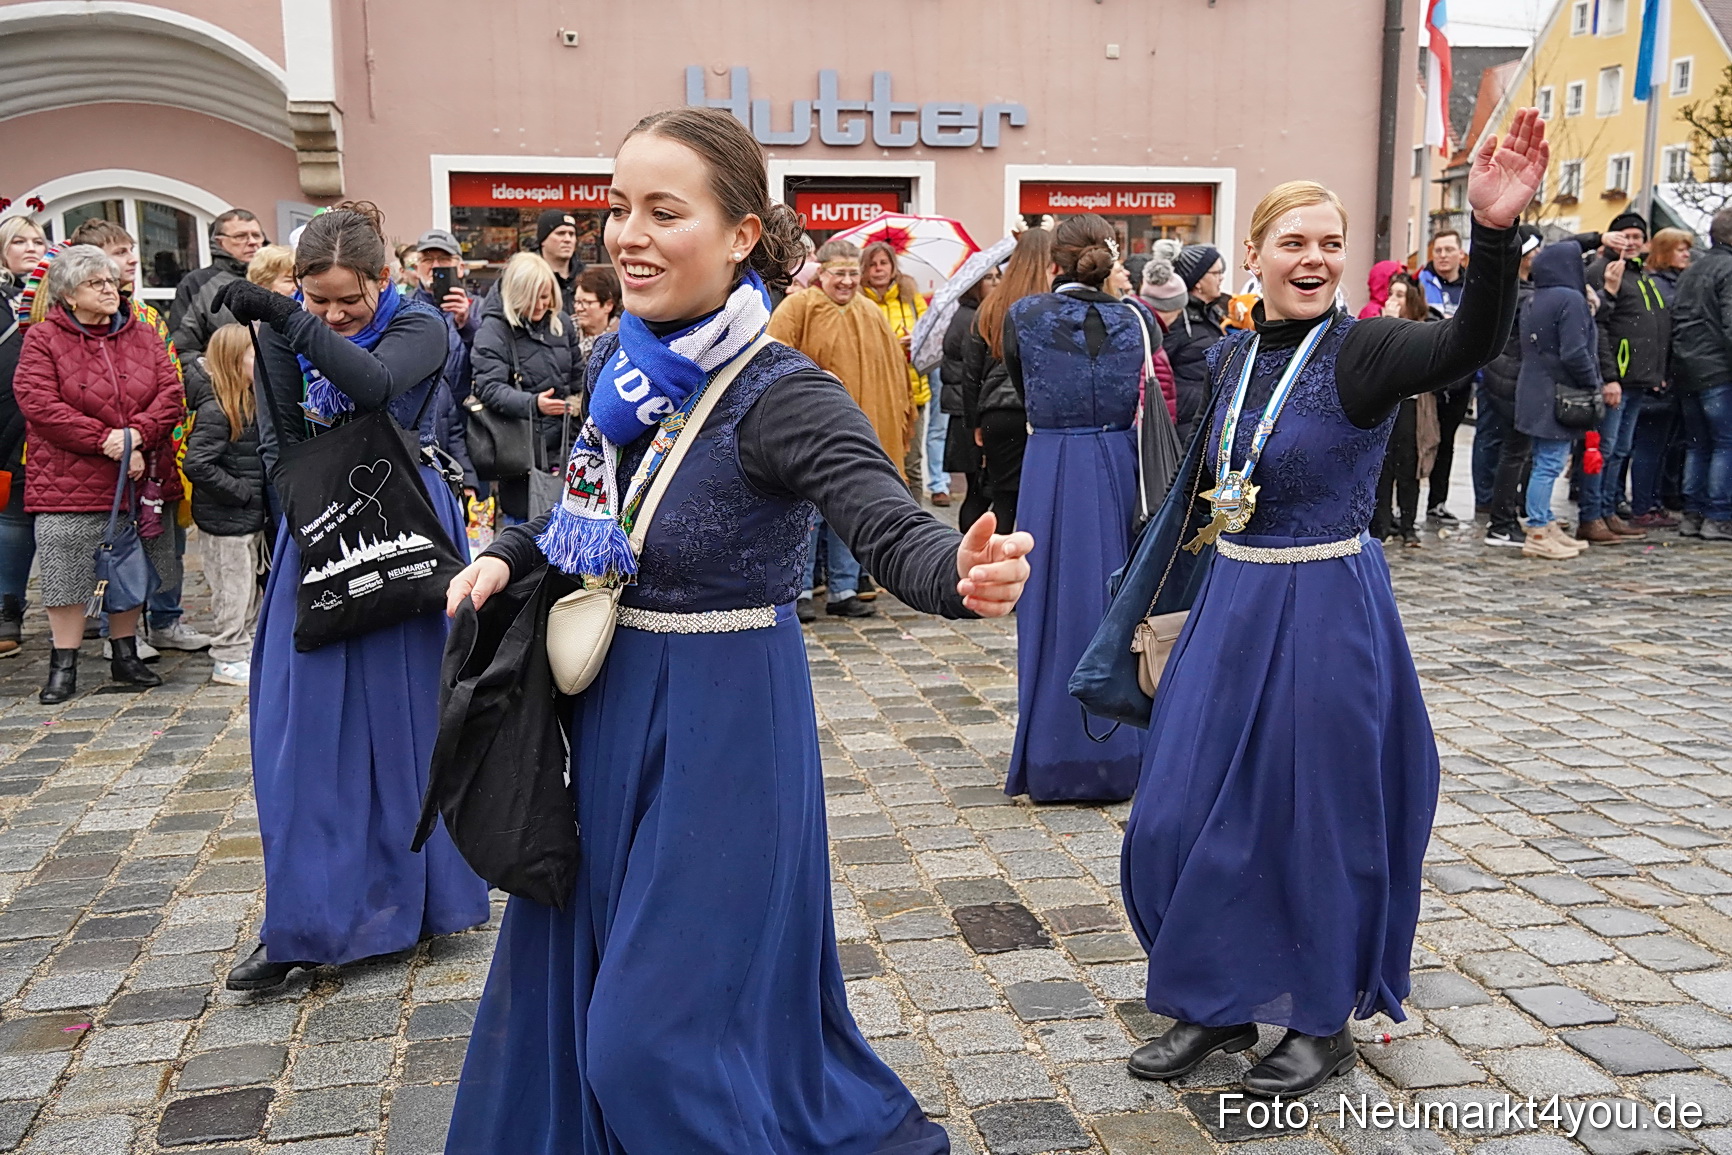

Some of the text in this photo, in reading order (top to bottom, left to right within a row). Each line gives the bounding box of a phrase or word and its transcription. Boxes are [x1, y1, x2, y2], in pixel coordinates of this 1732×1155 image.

[685, 65, 1028, 149] Hutter
[569, 185, 611, 201] HUT
[1116, 192, 1176, 208] HUTTER
[811, 203, 882, 221] HUTTER
[323, 521, 338, 533] bin
[335, 512, 348, 524] ich
[347, 497, 364, 516] gern!
[387, 560, 431, 579] NEUMARKT
